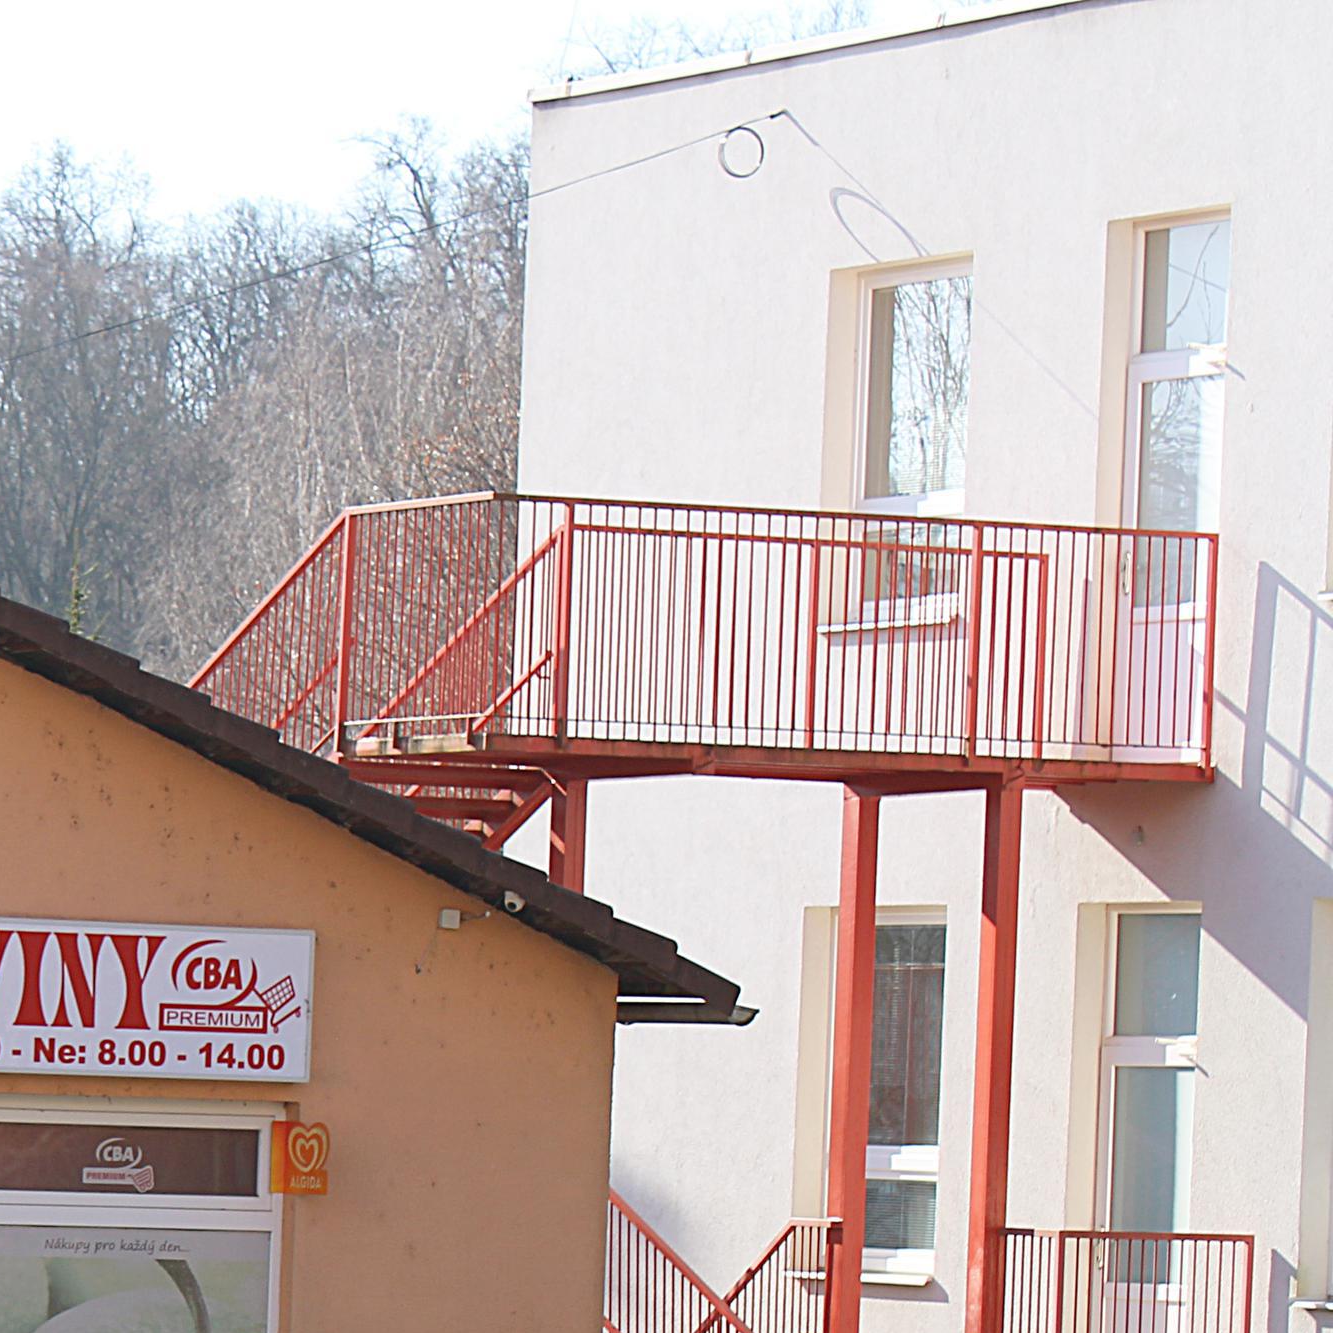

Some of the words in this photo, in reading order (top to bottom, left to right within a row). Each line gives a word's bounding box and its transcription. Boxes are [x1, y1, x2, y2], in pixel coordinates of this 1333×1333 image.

[186, 957, 242, 990] CBA
[166, 1010, 260, 1027] PREMIUM
[33, 1037, 86, 1064] Ne:
[97, 1040, 166, 1066] 8.00
[199, 1043, 285, 1070] 14.00
[103, 1146, 134, 1161] CBA
[86, 1171, 126, 1180] PREMIUM
[290, 1176, 322, 1189] ALGIDA
[44, 1238, 91, 1254] Nákupy
[95, 1241, 115, 1254] pro
[120, 1239, 155, 1255] každý
